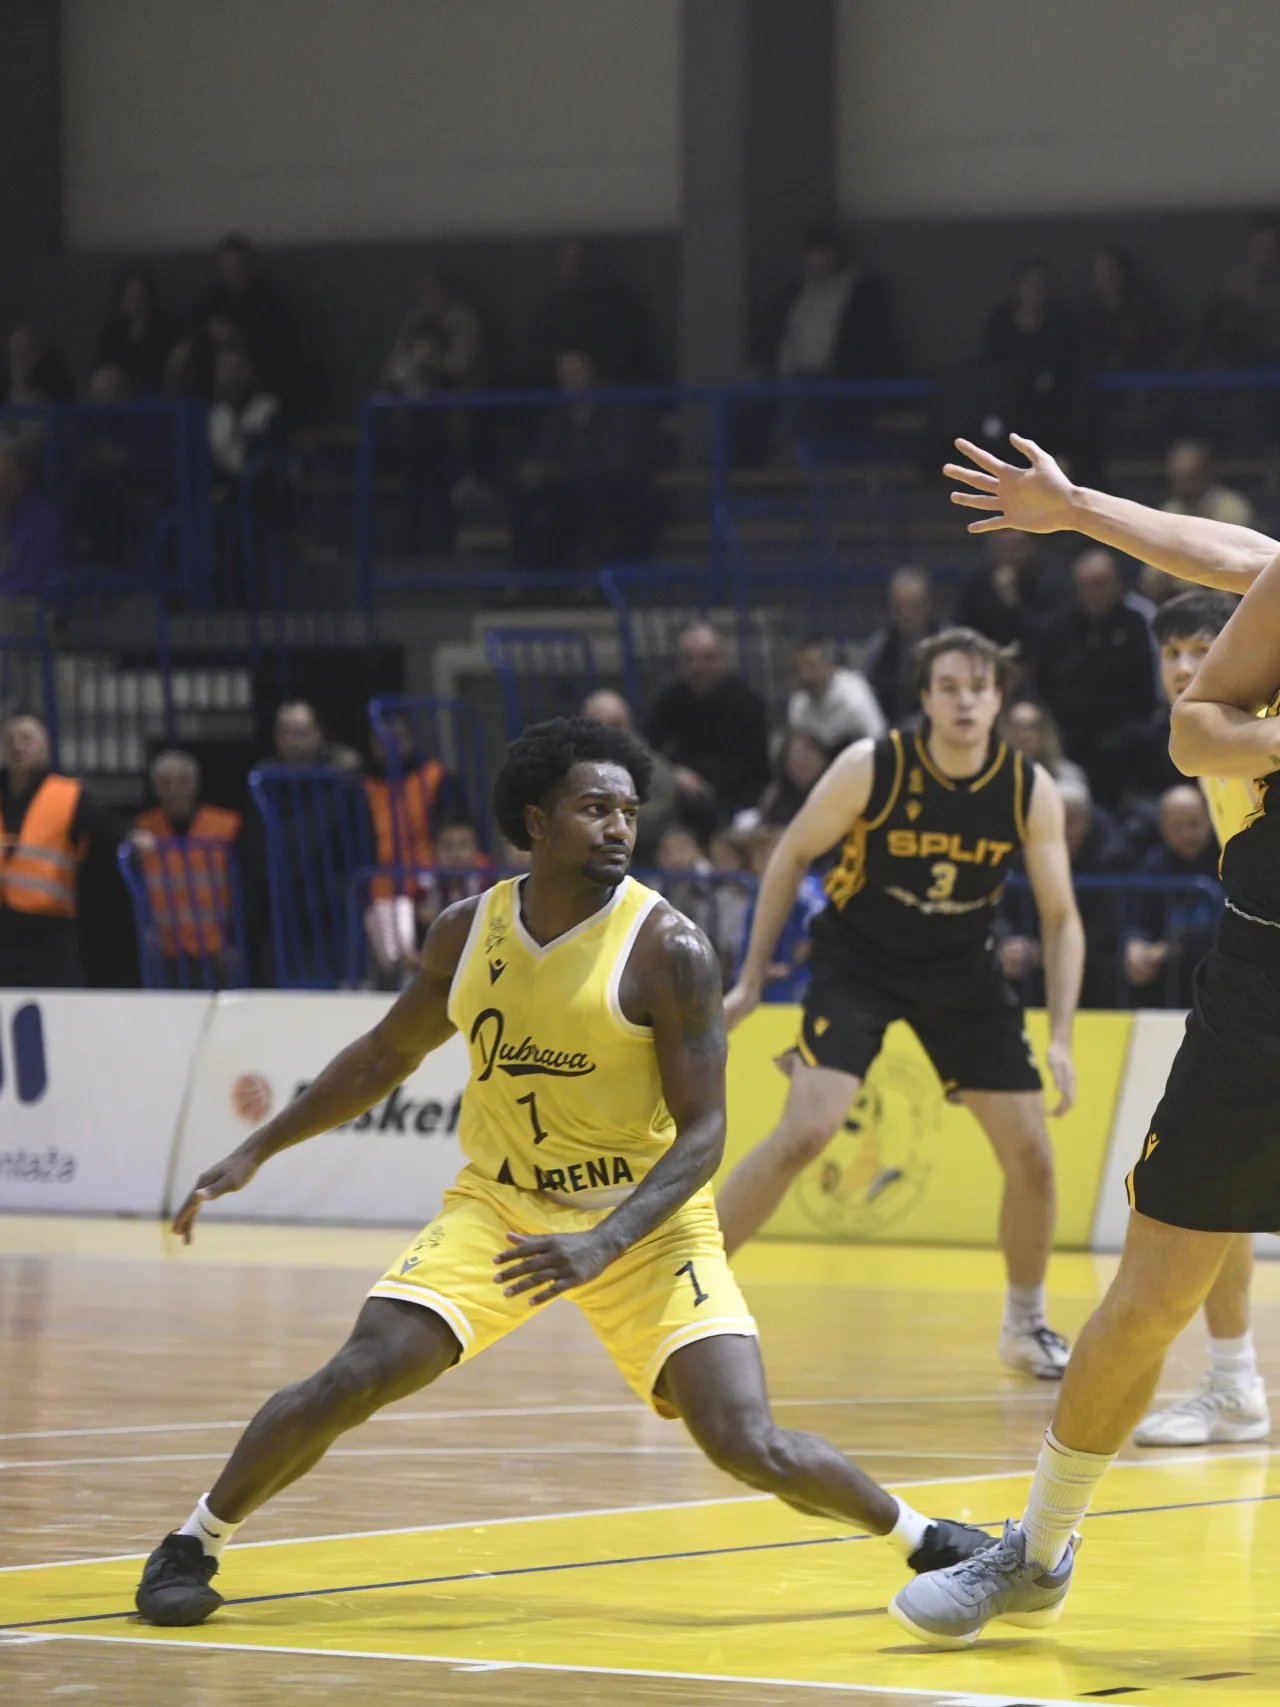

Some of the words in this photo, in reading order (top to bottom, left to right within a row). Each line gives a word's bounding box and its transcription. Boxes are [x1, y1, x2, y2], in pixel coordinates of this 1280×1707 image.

[887, 829, 1013, 866] SPLIT
[927, 861, 958, 900] 3
[471, 1008, 596, 1081] Dubrava
[516, 1091, 548, 1145] 1
[533, 1156, 635, 1194] ARENA
[674, 1261, 709, 1307] 1
